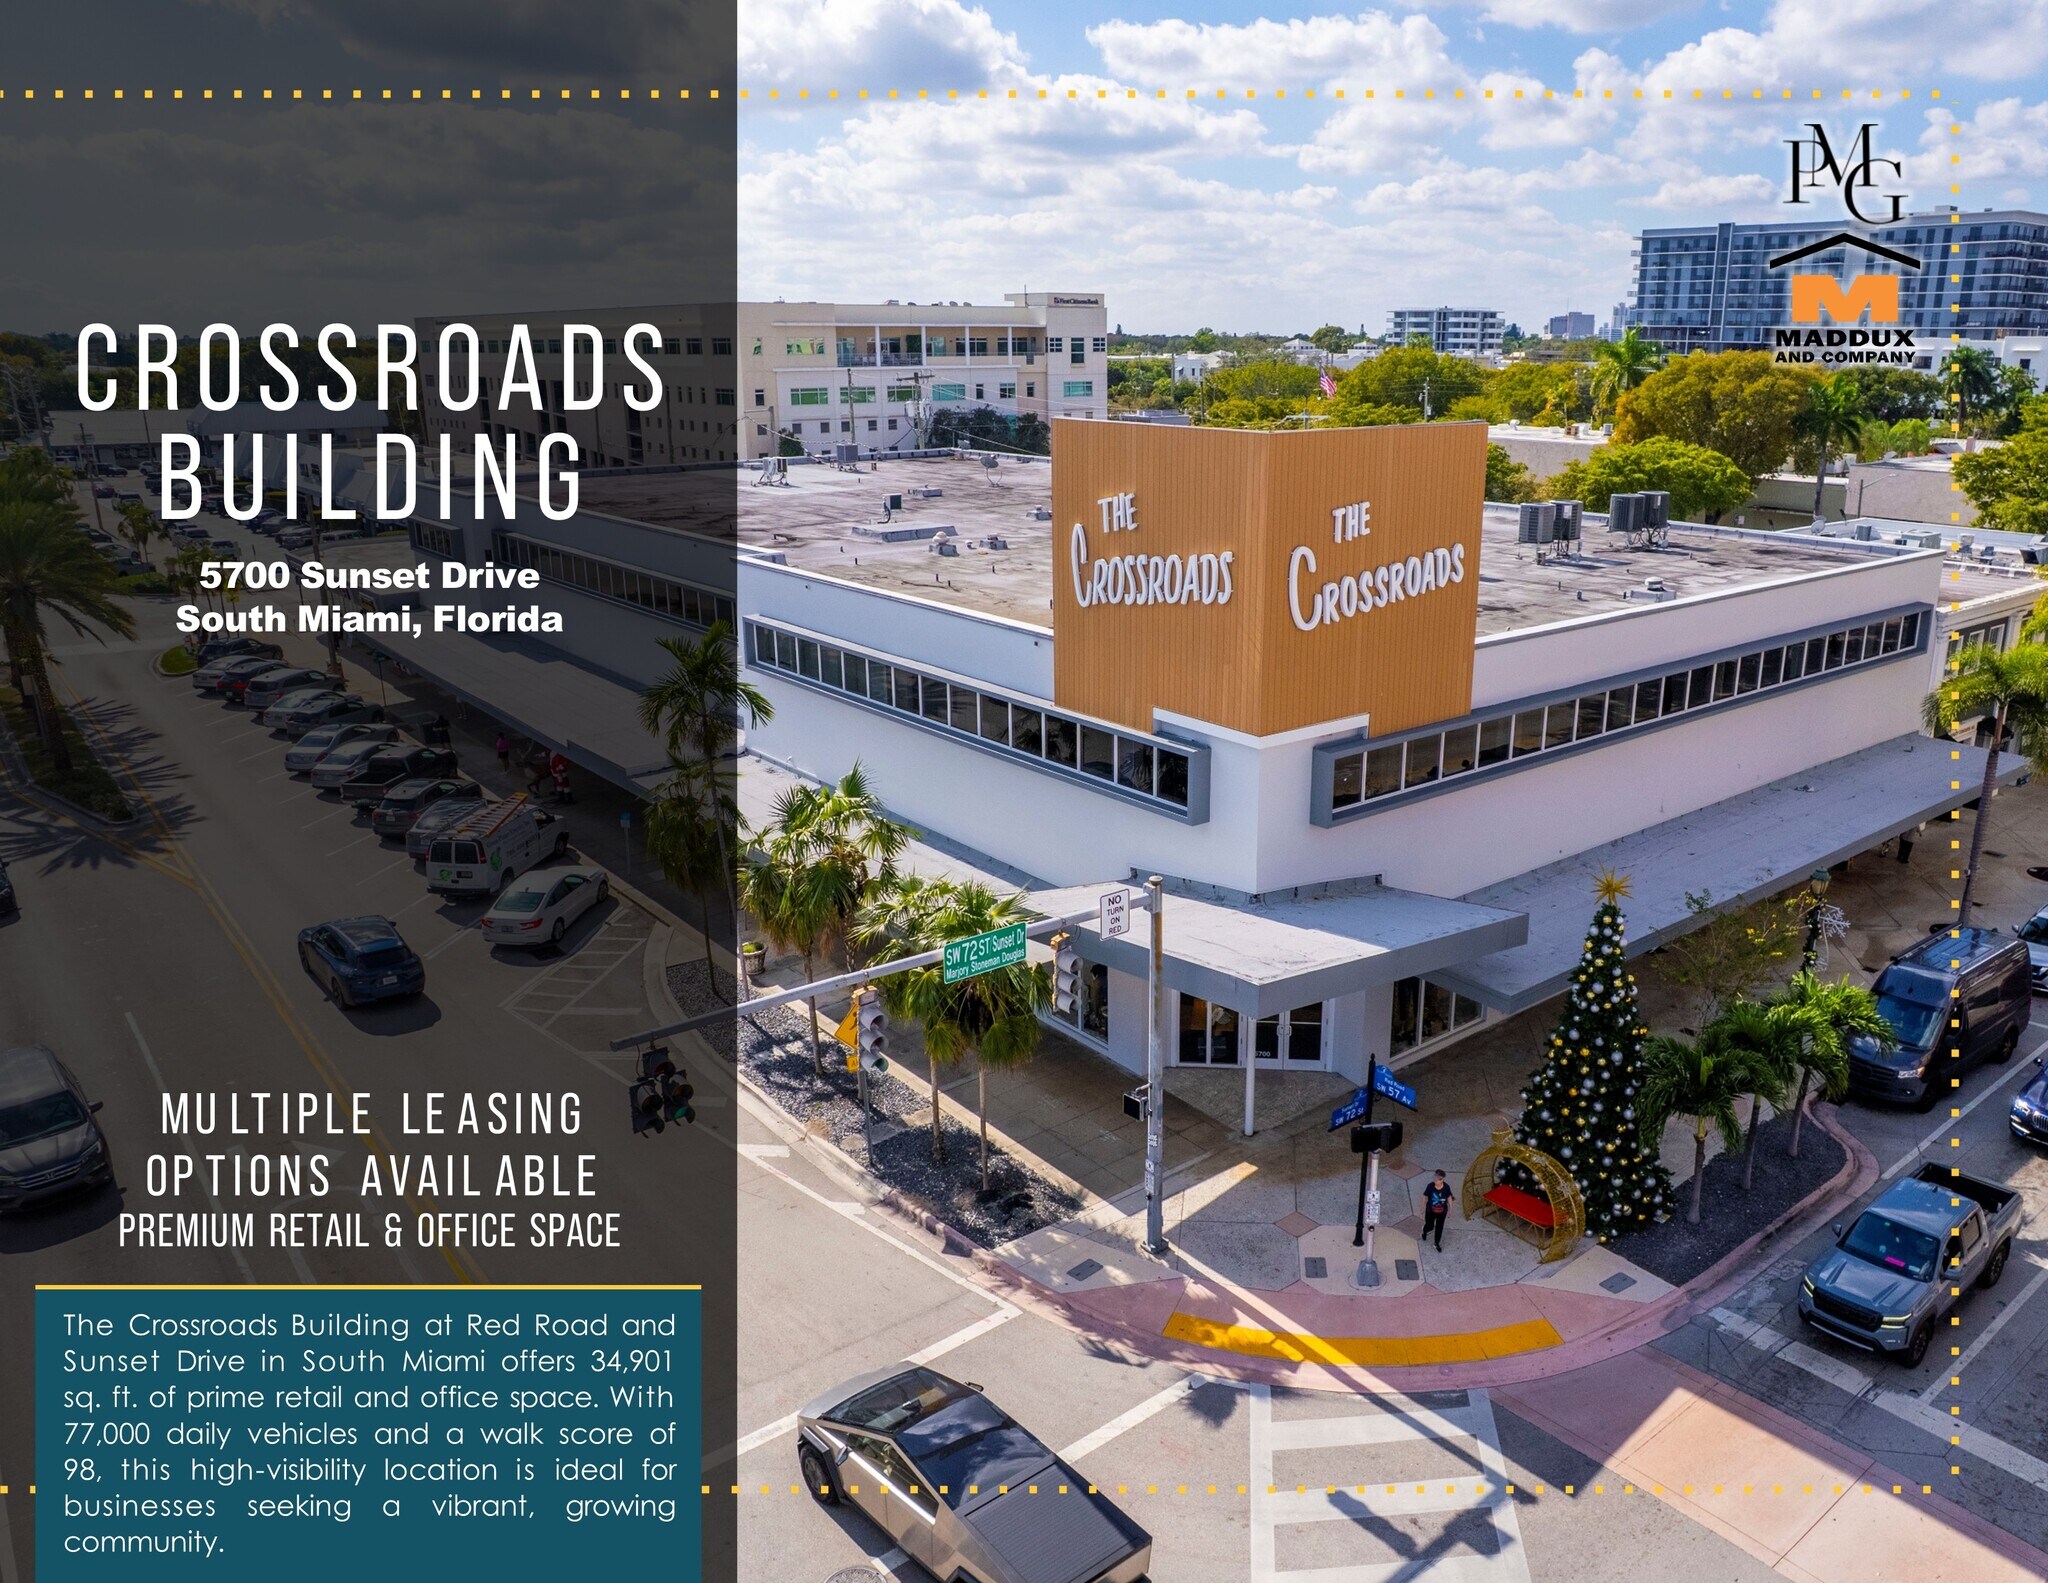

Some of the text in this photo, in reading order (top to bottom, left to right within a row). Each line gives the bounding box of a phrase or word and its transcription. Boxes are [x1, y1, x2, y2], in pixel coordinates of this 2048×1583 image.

[1097, 492, 1138, 533] THE
[1331, 501, 1371, 544] THE
[1070, 523, 1234, 608] CROSSROADS
[1288, 543, 1465, 631] CROSSROADS
[1107, 905, 1124, 916] TURN
[1108, 895, 1121, 906] NO
[1109, 925, 1122, 934] RED
[1110, 916, 1120, 924] ON
[946, 928, 1024, 966] SW 72 ST Sunset Dr
[946, 948, 1025, 980] Marjory Stoneman Douglas
[1376, 1082, 1412, 1105] SW 57 Av
[1335, 1107, 1364, 1126] SW 72 St
